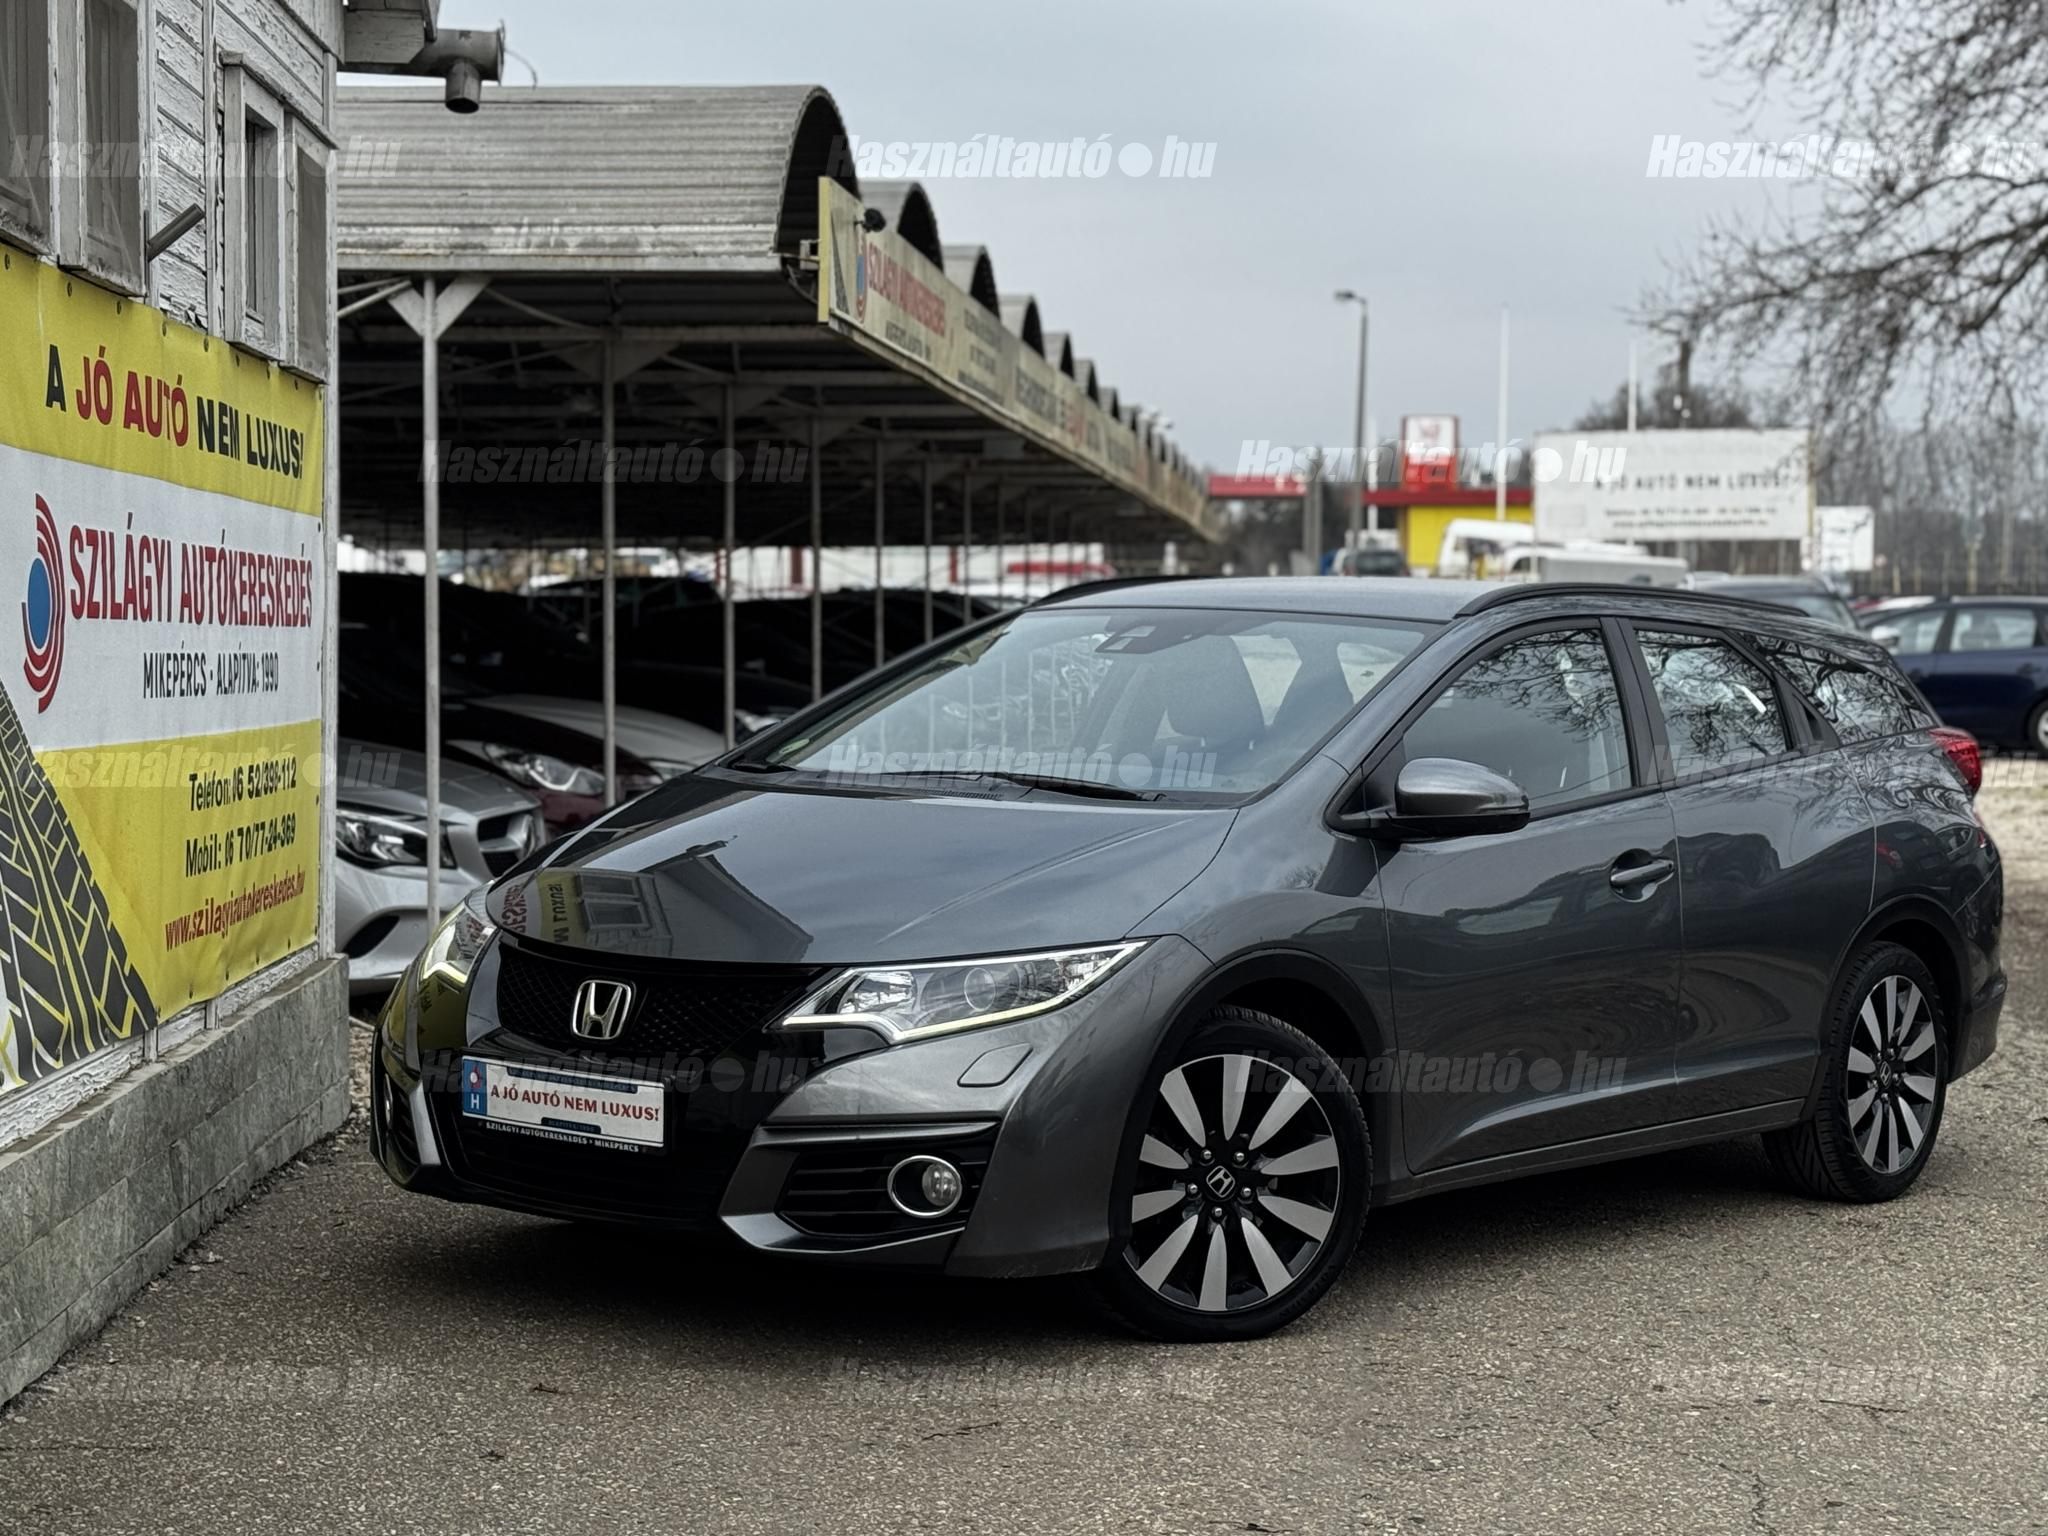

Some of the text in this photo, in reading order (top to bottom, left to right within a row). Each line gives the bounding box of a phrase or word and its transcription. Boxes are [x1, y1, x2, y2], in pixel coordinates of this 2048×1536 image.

[45, 344, 305, 480] A JÓ AUTÓ NEM LUXUS!
[69, 511, 313, 627] SZILÁGYI AUTÓKERESKEDÉS
[143, 640, 207, 699] MIKEPÉRCS
[216, 641, 260, 696] ALAPÍTVA:
[261, 651, 279, 693] 1990
[185, 832, 222, 878] Mobil:
[470, 1093, 480, 1110] H
[490, 1083, 660, 1121] A JÓ AUTÓ NEM LUXUS!
